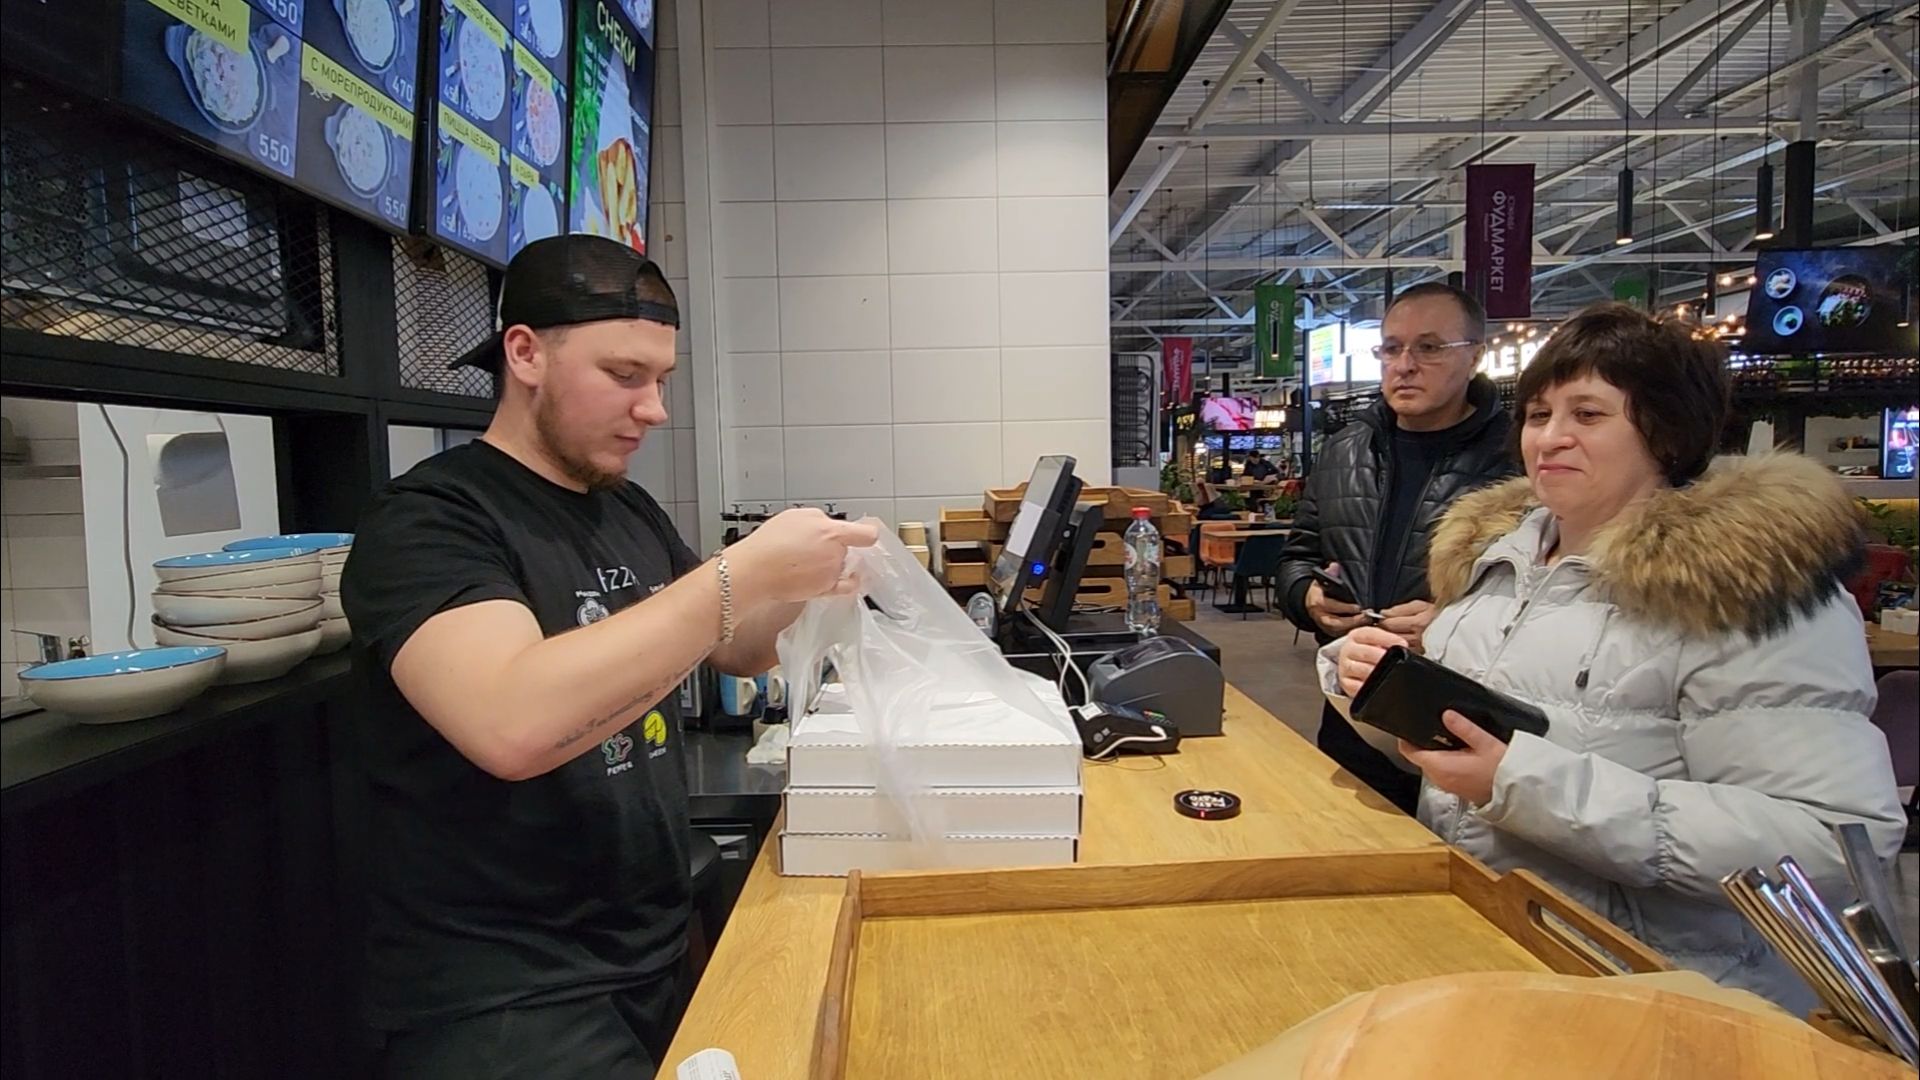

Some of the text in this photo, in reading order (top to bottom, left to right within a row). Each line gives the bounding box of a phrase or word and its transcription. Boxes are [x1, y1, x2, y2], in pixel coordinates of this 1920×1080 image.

[597, 1, 636, 73] СНЕКИ
[311, 57, 412, 131] С МОРЕПРОДУКТАМИ
[392, 75, 413, 103] 470
[259, 133, 290, 167] 550
[385, 196, 406, 221] 550
[1490, 190, 1507, 293] ФУДМАРКЕТ
